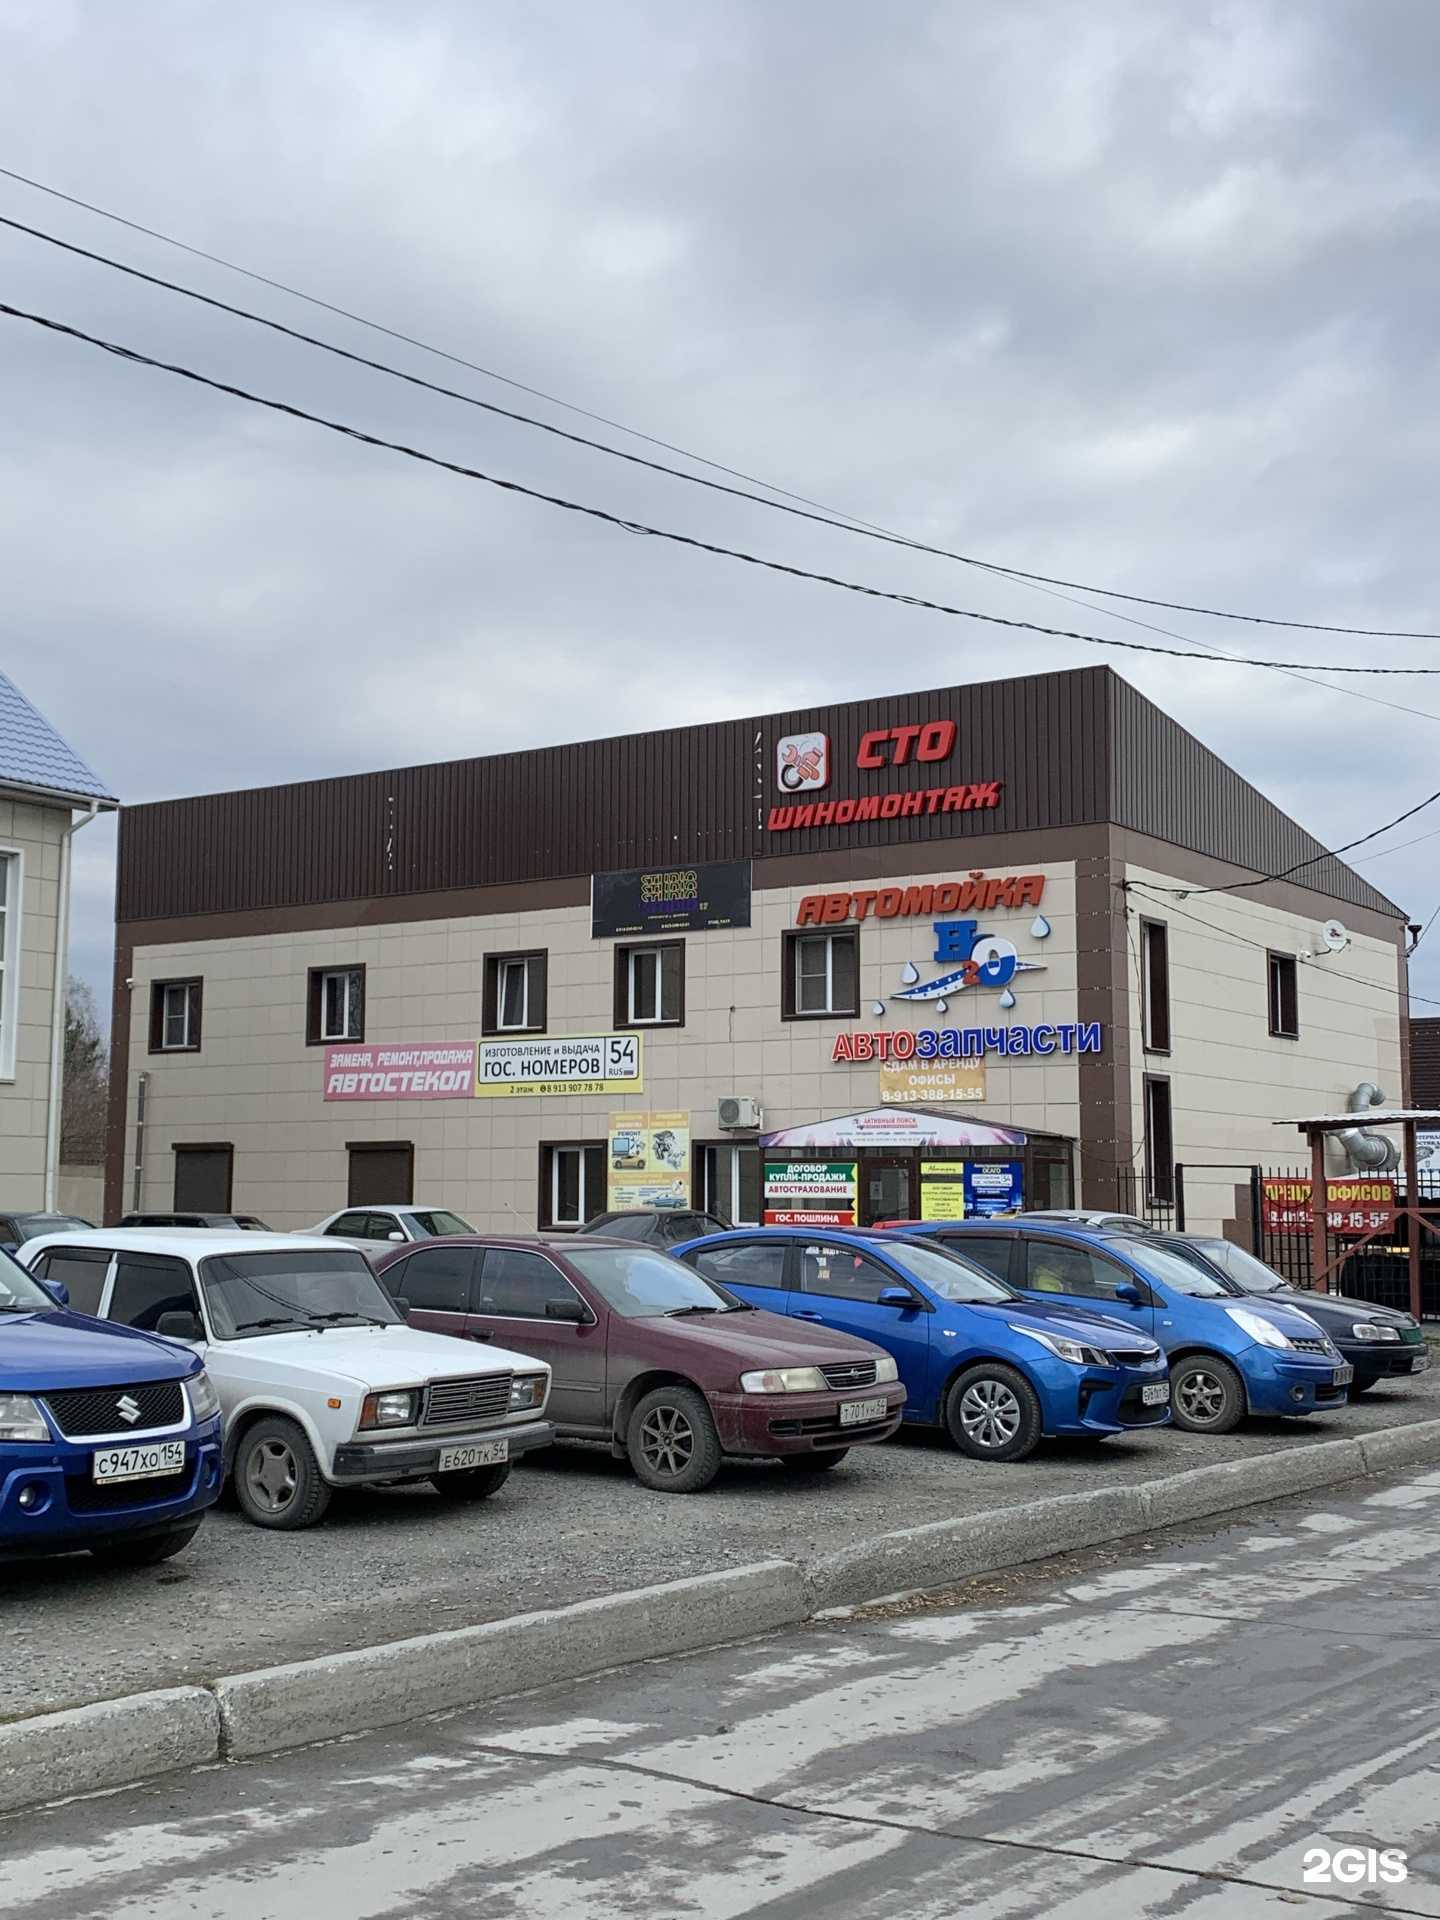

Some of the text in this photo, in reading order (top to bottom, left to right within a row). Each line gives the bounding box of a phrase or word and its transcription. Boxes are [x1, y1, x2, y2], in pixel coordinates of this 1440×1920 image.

[857, 720, 958, 769] СТО
[767, 781, 1003, 831] ШИНОМОНТАЖ
[796, 870, 1046, 925] АВТОМОЙКА
[832, 1022, 1102, 1063] АВТОзапчасти
[485, 1044, 600, 1058] ИЗГОТОВЛЕНИЕ и ВЫДАЧА
[610, 1040, 634, 1064] 54
[330, 1053, 374, 1068] ЗАМЕНА,
[485, 1058, 600, 1077] ГОС. НОМЕРОВ
[920, 1060, 930, 1070] В
[608, 1067, 623, 1076] RUS
[908, 1074, 956, 1085] ОФИСЫ
[328, 1070, 473, 1094] АВТОСТЕКОЛ
[787, 1164, 827, 1174] ДОГОВОР
[769, 1173, 847, 1183] КУПЛИ-ПРОДАЖИ
[768, 1185, 848, 1193] АВТОСТРАХОВАНИЕ
[1327, 1185, 1391, 1201] ОФИСОВ
[775, 1214, 839, 1223] ГОС. ПОШЛИНА
[161, 1443, 182, 1460] 154
[444, 1443, 504, 1468] Е620ТК 54
